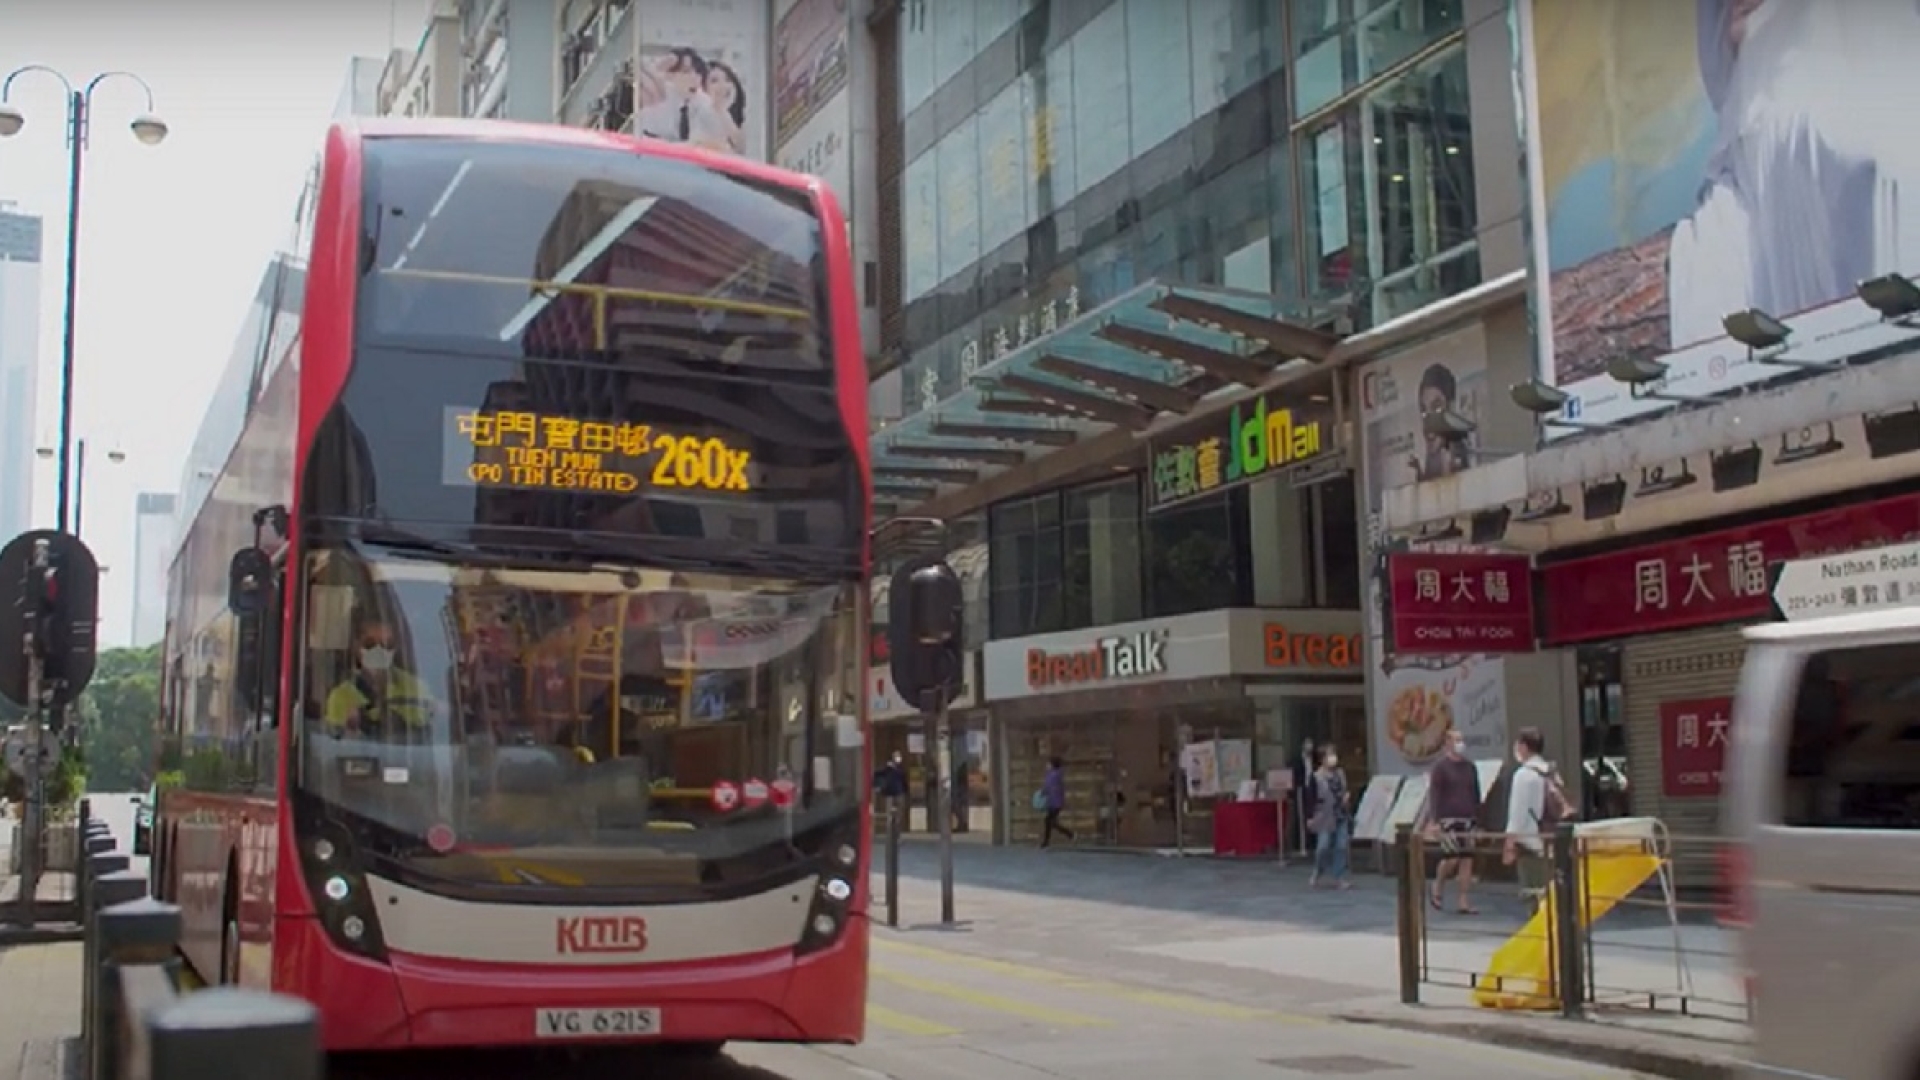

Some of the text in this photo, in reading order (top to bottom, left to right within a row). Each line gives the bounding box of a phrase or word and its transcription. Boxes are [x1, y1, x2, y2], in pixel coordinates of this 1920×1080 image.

[457, 410, 652, 455] 屯門寶田邨
[507, 447, 601, 470] TUEN MUN
[510, 466, 545, 485] TIN
[1634, 541, 1767, 613] 周大福
[1821, 551, 1919, 578] Nathan Road
[1415, 569, 1510, 602] 周大福
[556, 916, 649, 954] KMB
[547, 1010, 652, 1033] VG 6215
